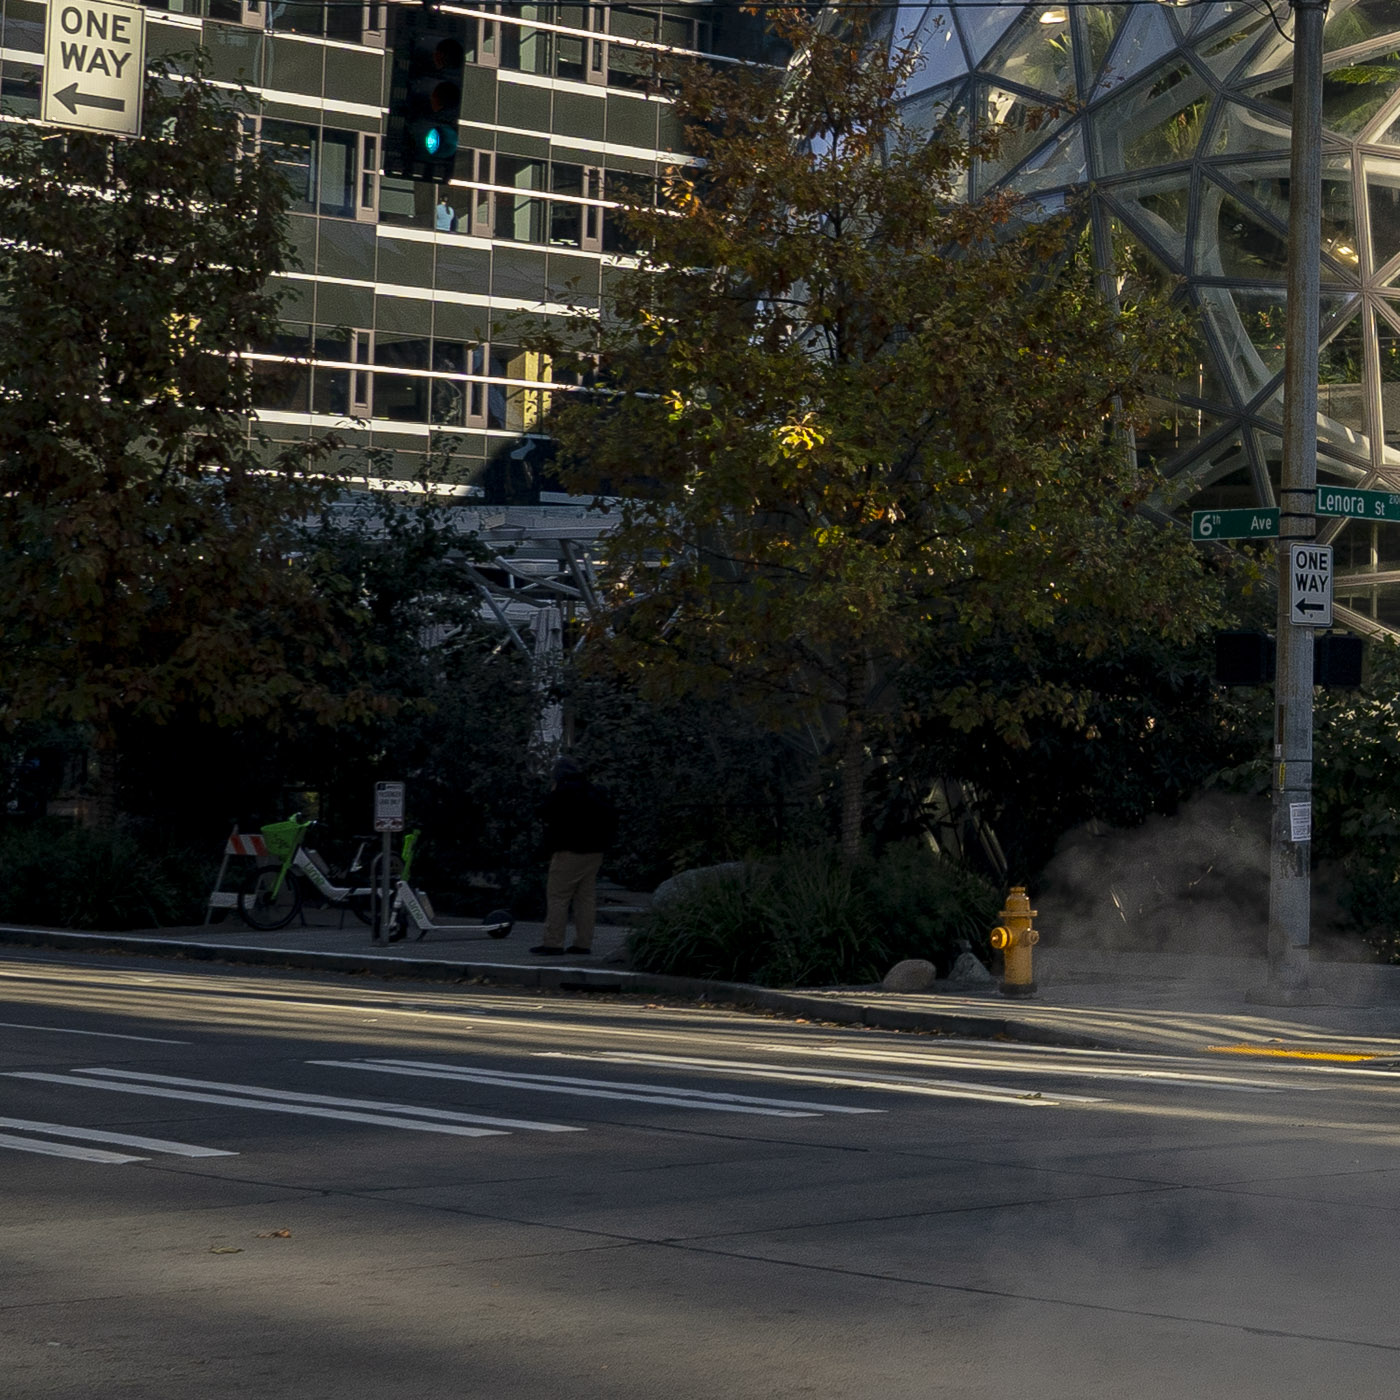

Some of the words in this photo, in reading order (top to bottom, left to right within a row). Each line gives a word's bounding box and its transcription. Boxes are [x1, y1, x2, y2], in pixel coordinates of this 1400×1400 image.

[61, 6, 131, 44] ONE
[61, 41, 132, 79] WAY
[1318, 489, 1364, 513] Lenora
[1375, 501, 1385, 516] St
[1199, 514, 1221, 536] 6th
[1250, 515, 1272, 531] Ave
[1296, 551, 1328, 571] ONE
[1295, 573, 1329, 593] WAY
